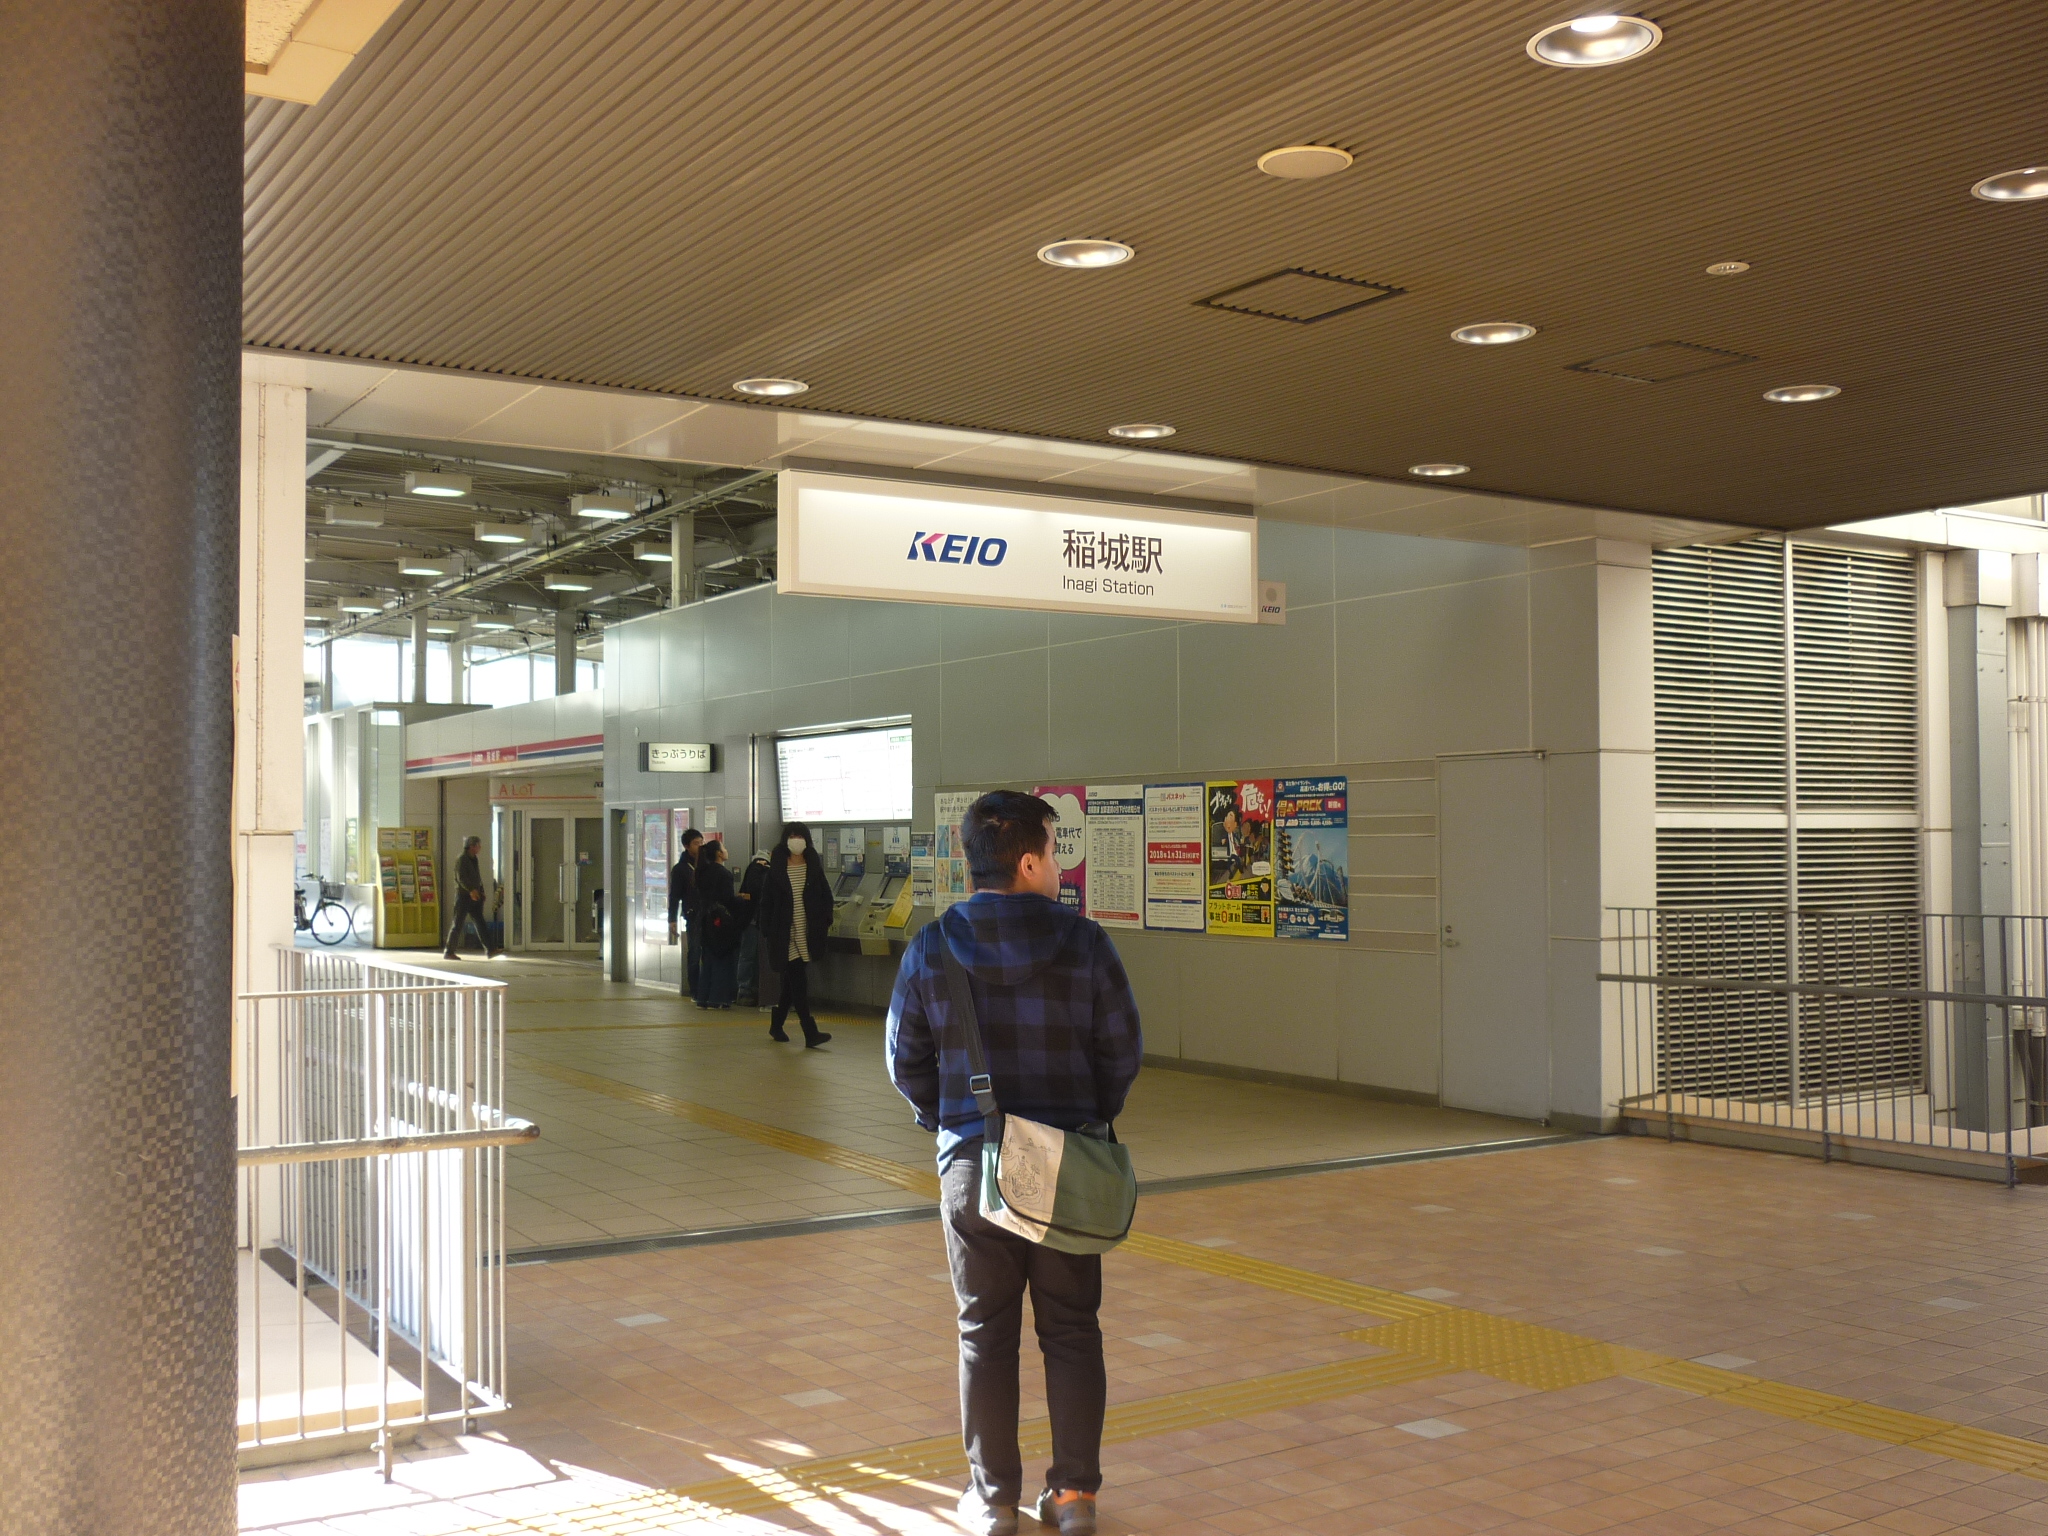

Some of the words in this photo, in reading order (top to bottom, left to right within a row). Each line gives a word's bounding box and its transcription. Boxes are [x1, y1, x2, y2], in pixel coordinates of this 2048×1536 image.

[906, 531, 1008, 567] KEIO
[1062, 528, 1163, 575] 稲城駅
[1062, 575, 1098, 594] Inagi
[1102, 578, 1154, 597] Station
[1261, 605, 1281, 614] KEIO
[651, 748, 707, 760] きっぷうりば
[1166, 792, 1187, 801] パスネット
[1208, 902, 1241, 911] プラットホーム
